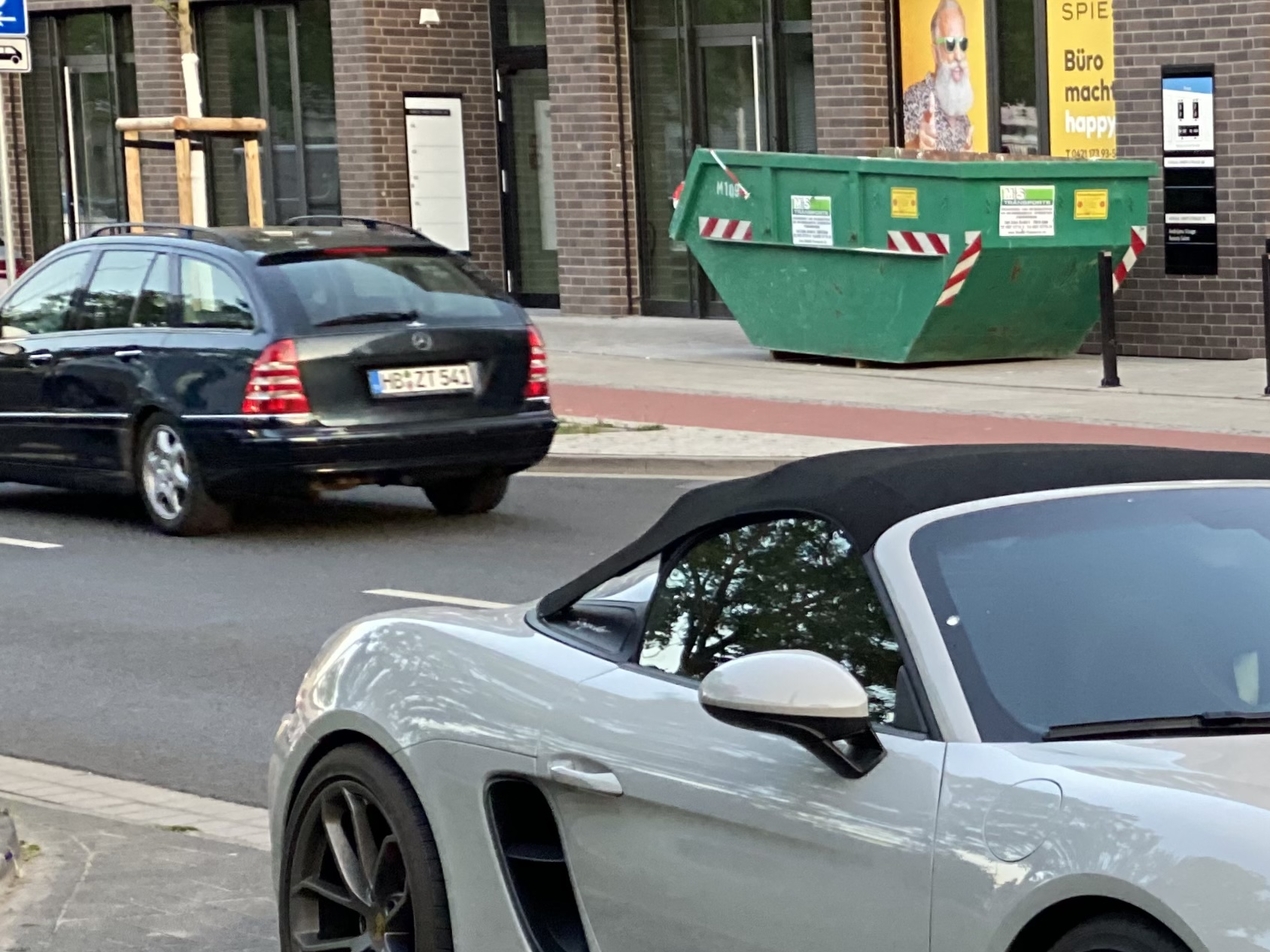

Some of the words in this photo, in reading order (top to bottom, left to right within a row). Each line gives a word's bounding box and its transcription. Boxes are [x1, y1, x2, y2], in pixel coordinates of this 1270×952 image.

[1062, 2, 1112, 20] SPIE
[1064, 48, 1103, 71] Büro
[1065, 79, 1113, 102] mach
[382, 372, 403, 390] HB
[415, 370, 435, 388] ZT
[440, 368, 470, 386] 541
